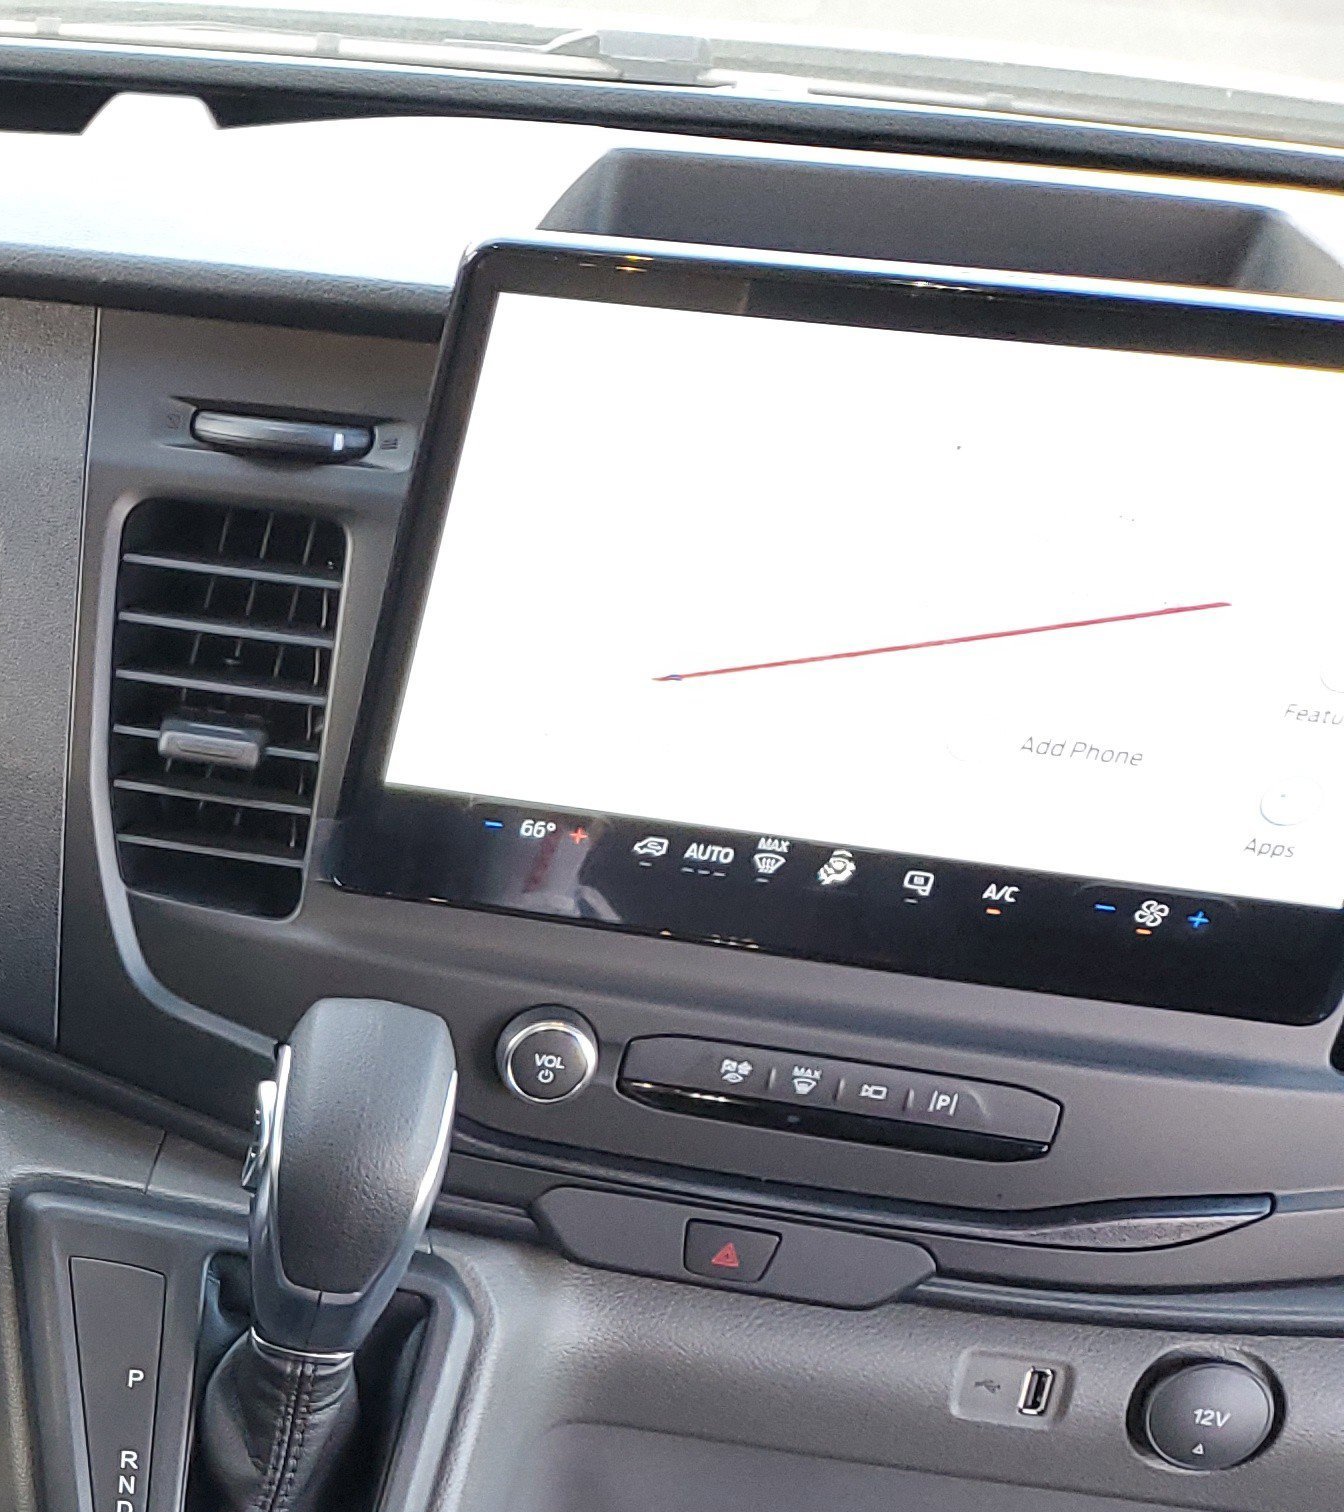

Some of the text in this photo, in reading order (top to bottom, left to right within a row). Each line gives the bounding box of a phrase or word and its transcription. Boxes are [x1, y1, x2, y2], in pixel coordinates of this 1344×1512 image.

[1020, 736, 1143, 766] Add Phone
[683, 842, 735, 864] AUTO
[758, 837, 790, 852] MAX
[1243, 838, 1295, 858] Apps
[982, 883, 1020, 903] A/C
[534, 1053, 565, 1070] VOL
[792, 1064, 823, 1081] MAX
[128, 1369, 144, 1388] P
[1193, 1408, 1230, 1428] 12V
[120, 1451, 139, 1470] R
[118, 1475, 136, 1495] N
